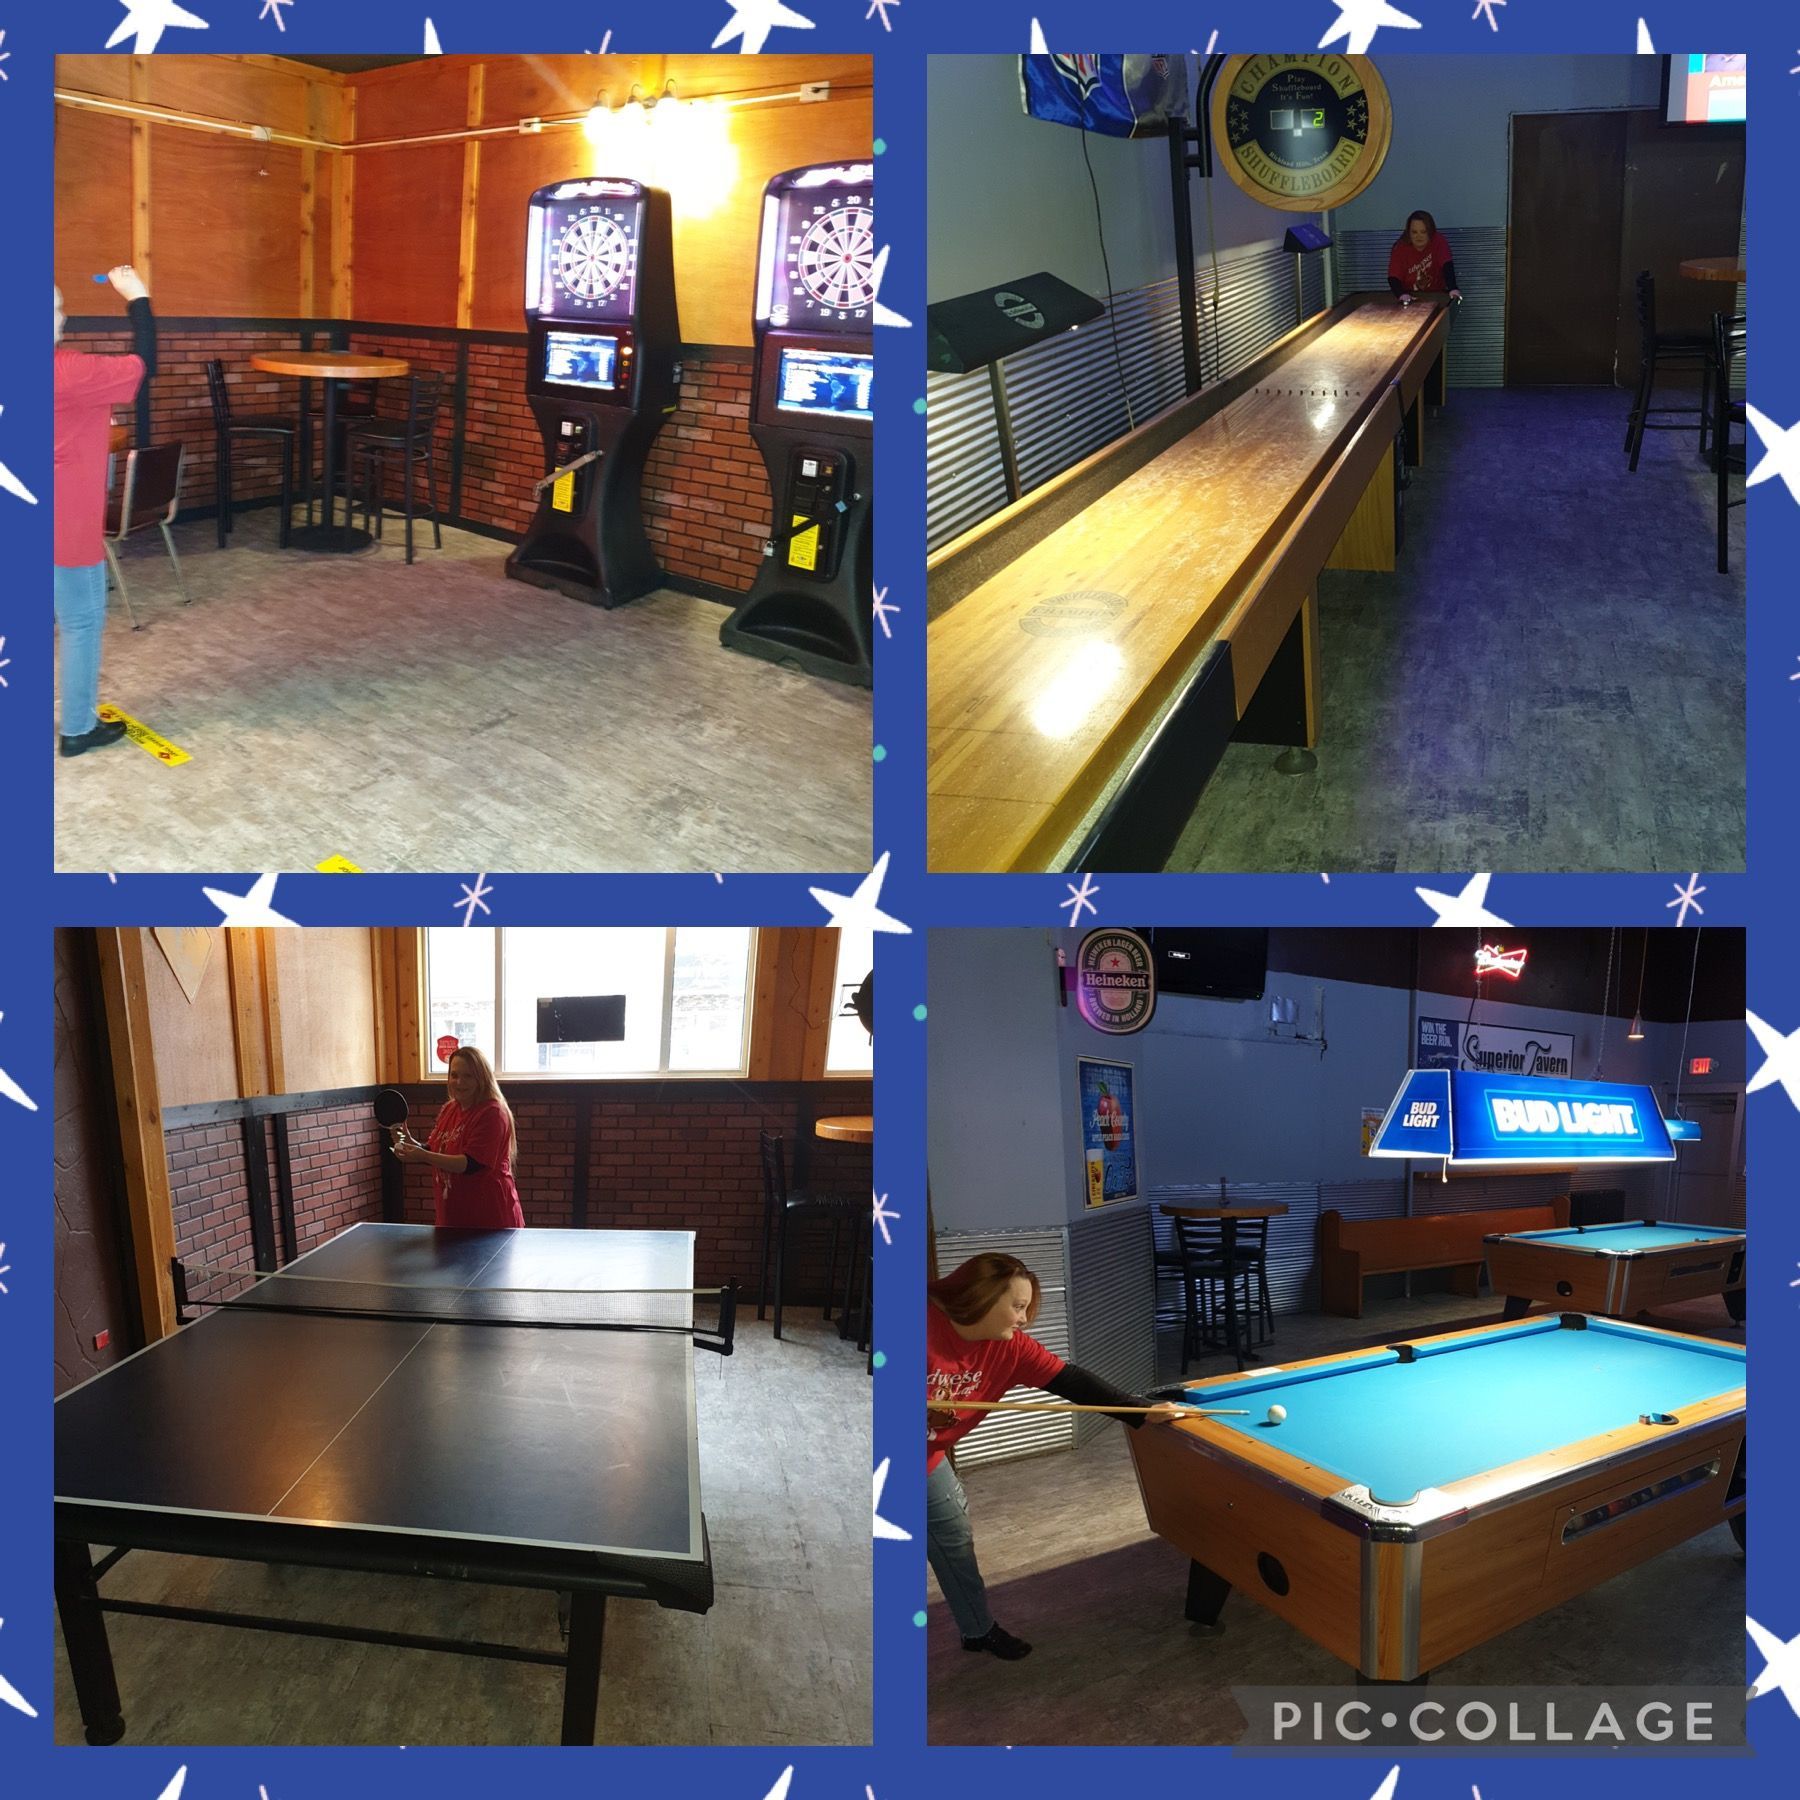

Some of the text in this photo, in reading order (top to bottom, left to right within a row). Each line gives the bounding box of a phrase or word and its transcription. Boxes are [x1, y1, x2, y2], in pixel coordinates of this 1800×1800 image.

[1312, 111, 1324, 128] 2
[1240, 143, 1357, 192] SHUFFLEBOARD
[831, 199, 840, 207] 5
[847, 195, 862, 205] 20
[1086, 973, 1146, 988] Heineken
[1421, 1021, 1447, 1035] WIN THE
[1421, 1033, 1438, 1046] BEER
[1462, 1034, 1568, 1076] Superior Tavern
[1410, 1101, 1438, 1115] BUD
[1402, 1114, 1440, 1129] LIGHT
[1491, 1098, 1638, 1135] BUD LIGHT
